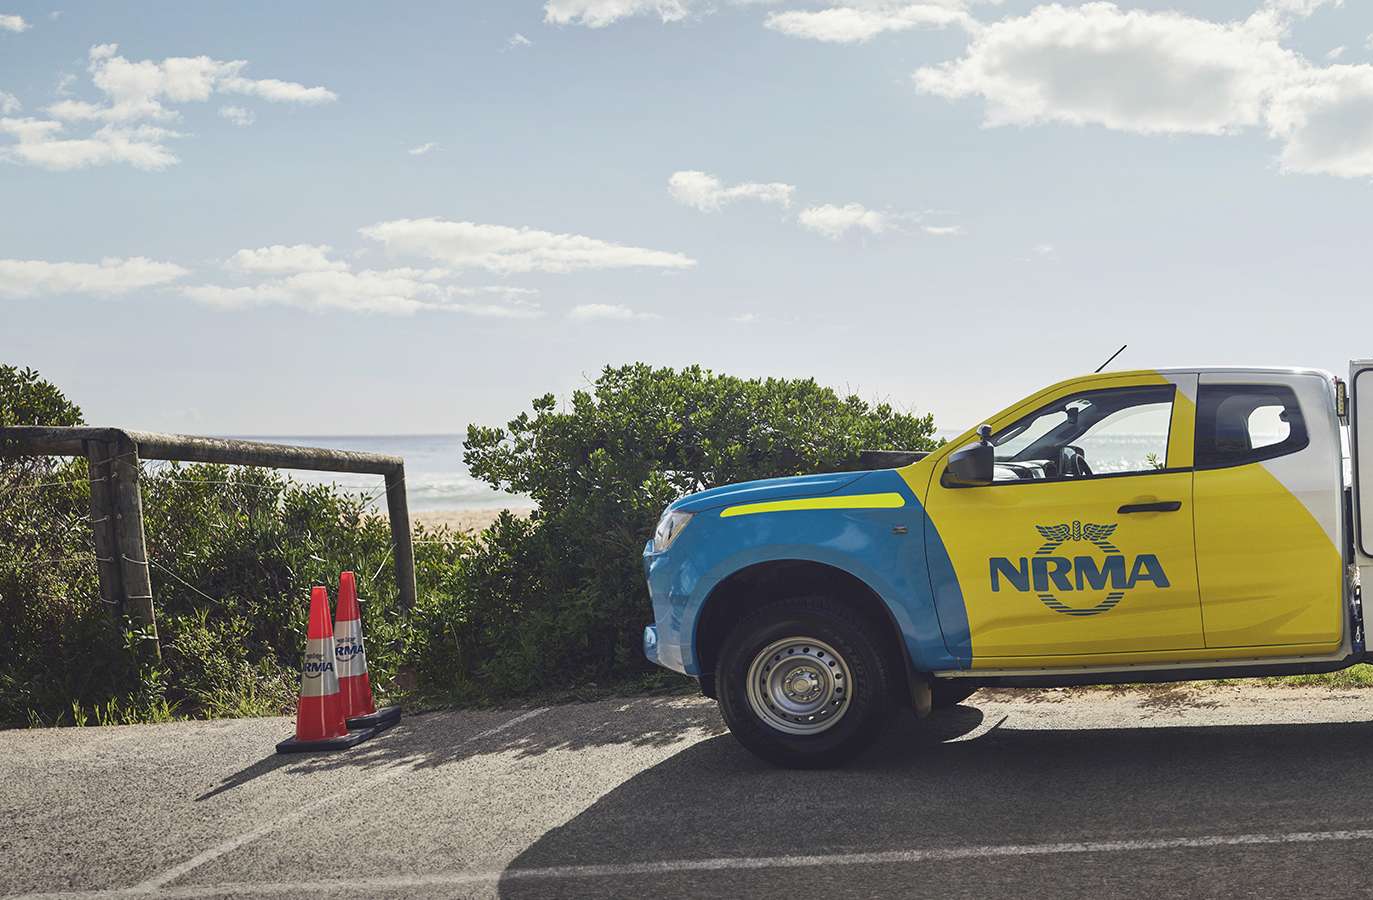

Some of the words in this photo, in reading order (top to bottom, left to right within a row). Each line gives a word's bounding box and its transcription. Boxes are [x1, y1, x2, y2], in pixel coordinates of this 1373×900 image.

[989, 554, 1171, 592] NRMA
[335, 645, 364, 656] RMA
[304, 662, 333, 672] RMA
